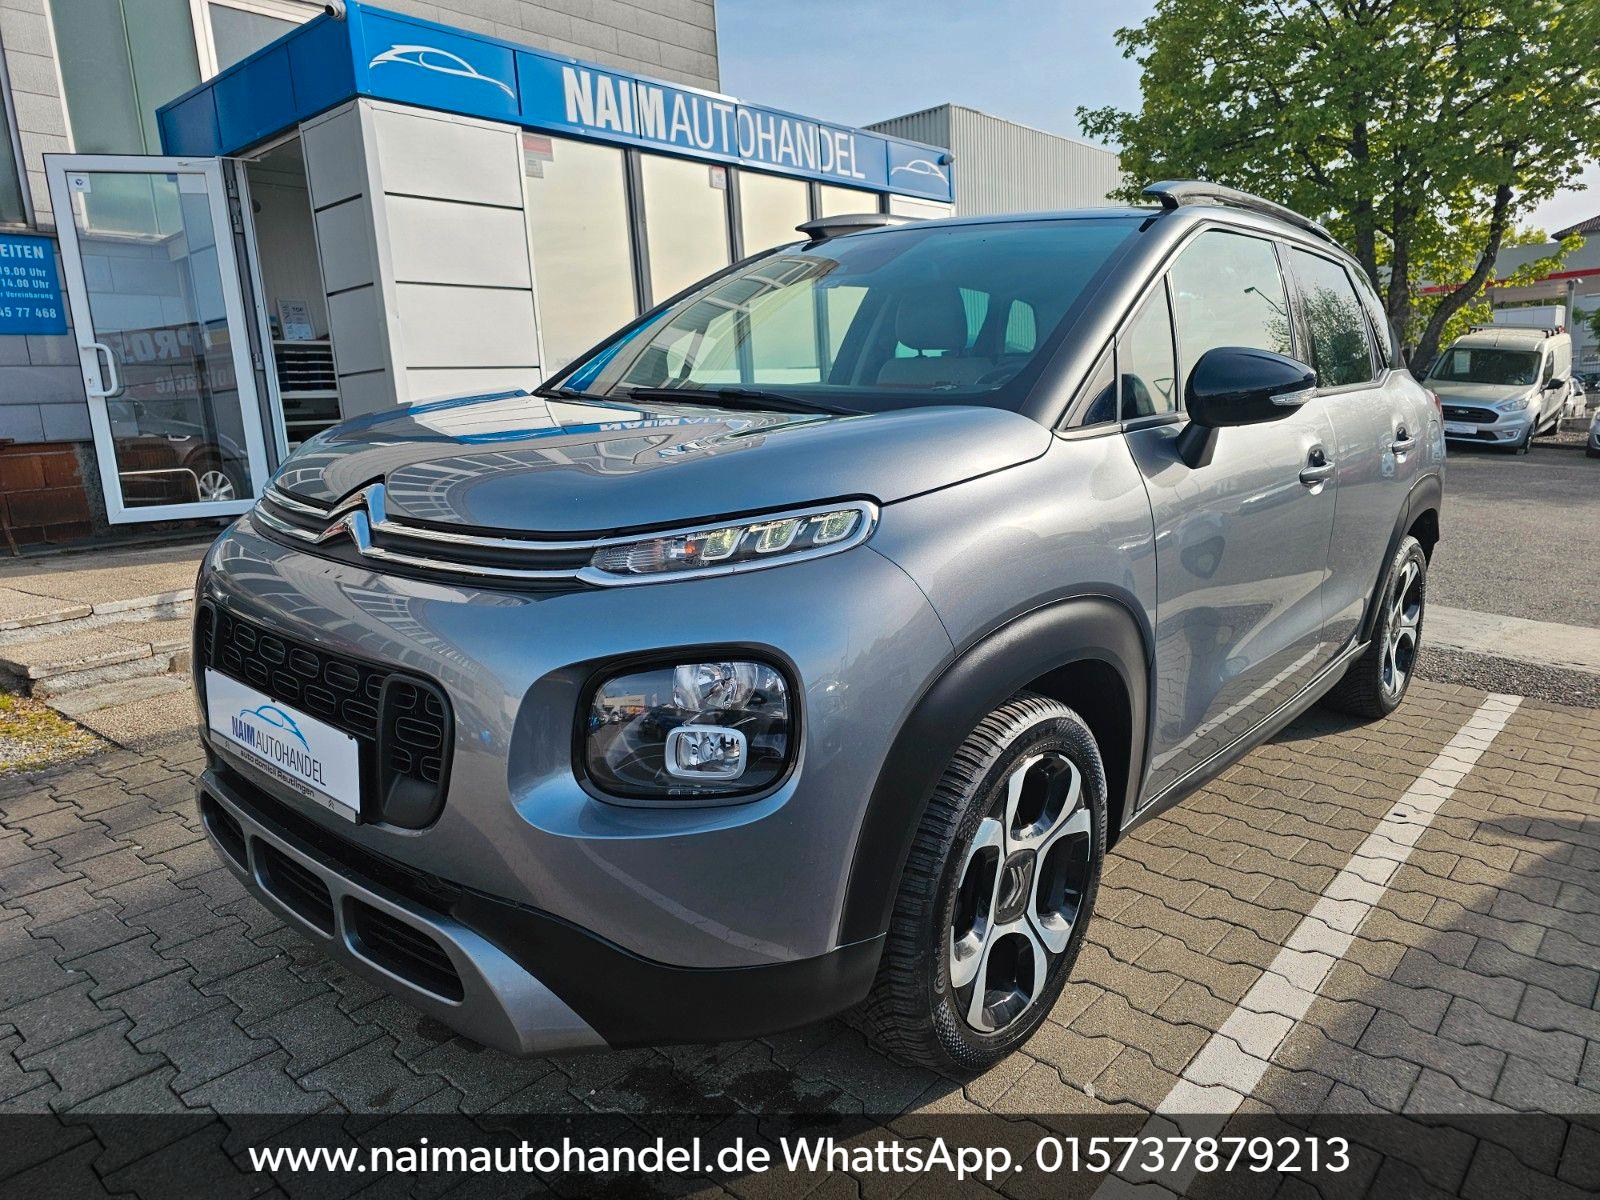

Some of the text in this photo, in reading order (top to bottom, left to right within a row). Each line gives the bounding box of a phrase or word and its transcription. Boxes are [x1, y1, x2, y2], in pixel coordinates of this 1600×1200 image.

[29, 268, 46, 277] Uhr
[32, 280, 49, 289] Uhr
[16, 307, 30, 318] 77
[35, 308, 57, 319] 468
[277, 770, 315, 798] Reutlingen
